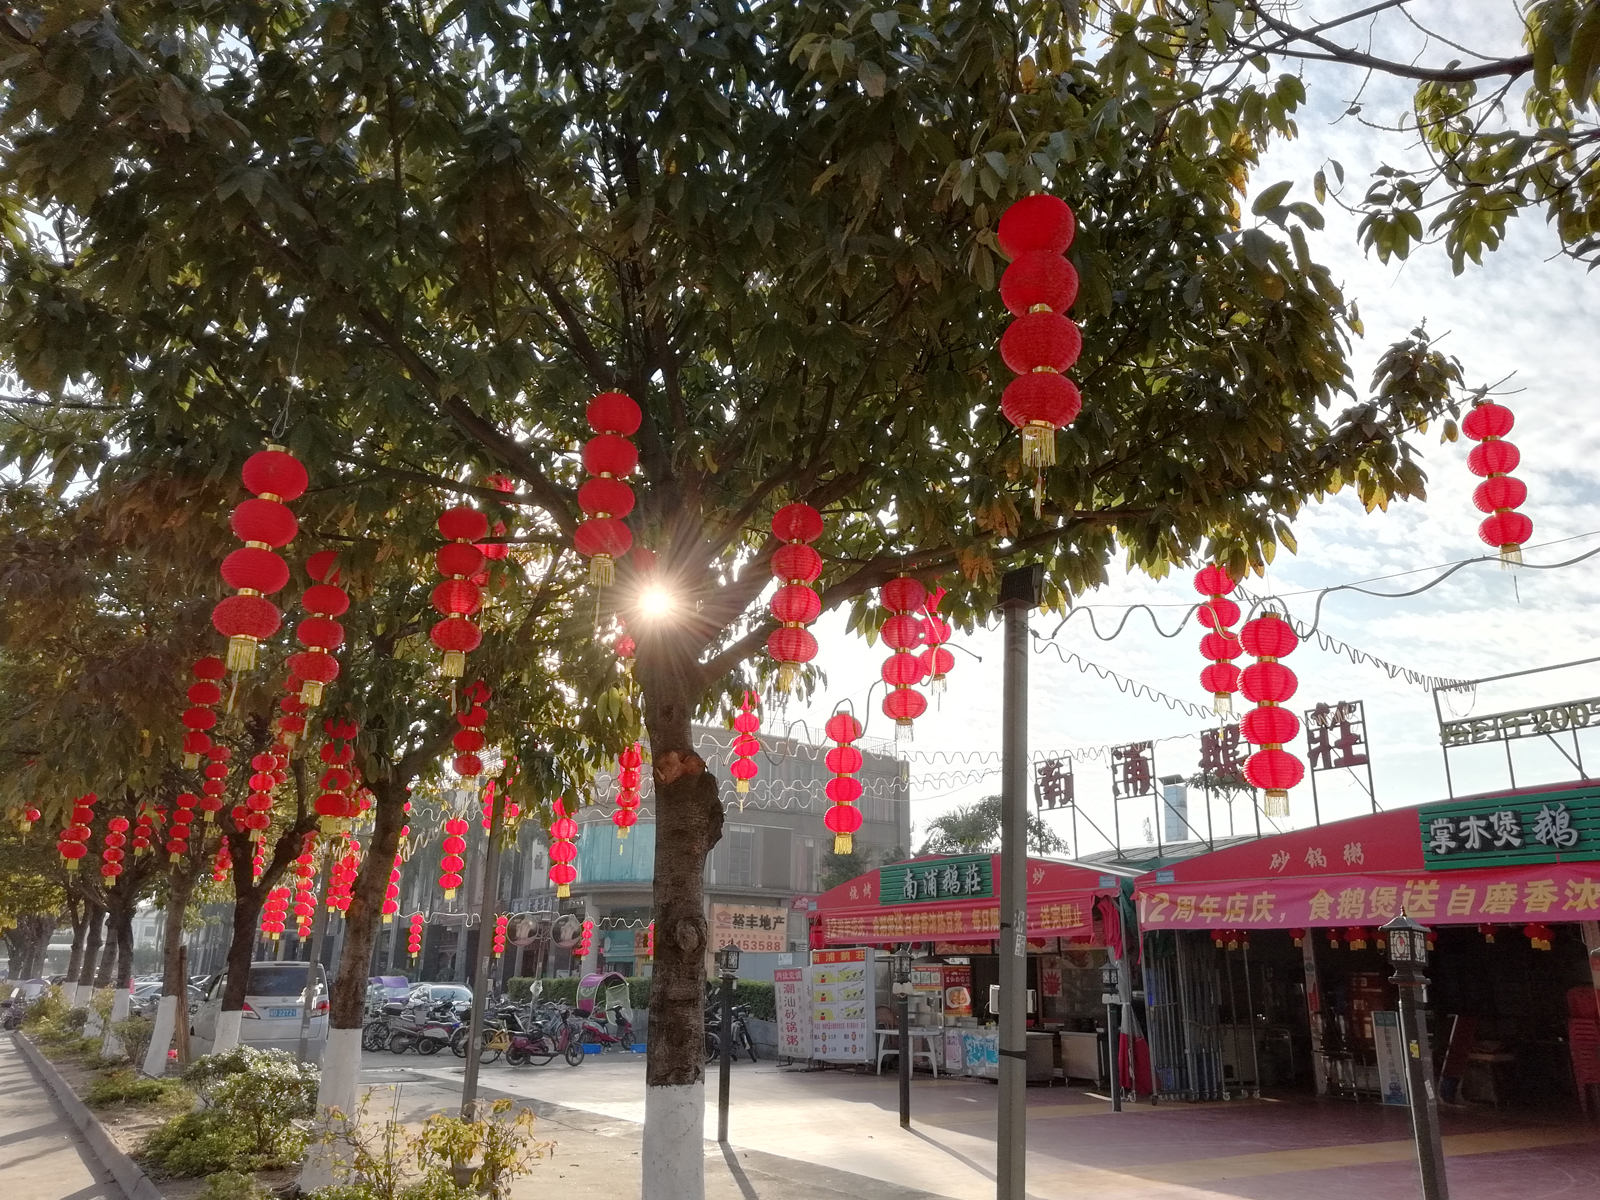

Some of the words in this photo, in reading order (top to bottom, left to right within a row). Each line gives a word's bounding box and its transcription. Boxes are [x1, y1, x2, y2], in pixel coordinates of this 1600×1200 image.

[1268, 842, 1365, 873] 砂锅粥
[732, 913, 786, 930] 裕丰地产
[783, 983, 799, 1046] 潮汕砂锅粥
